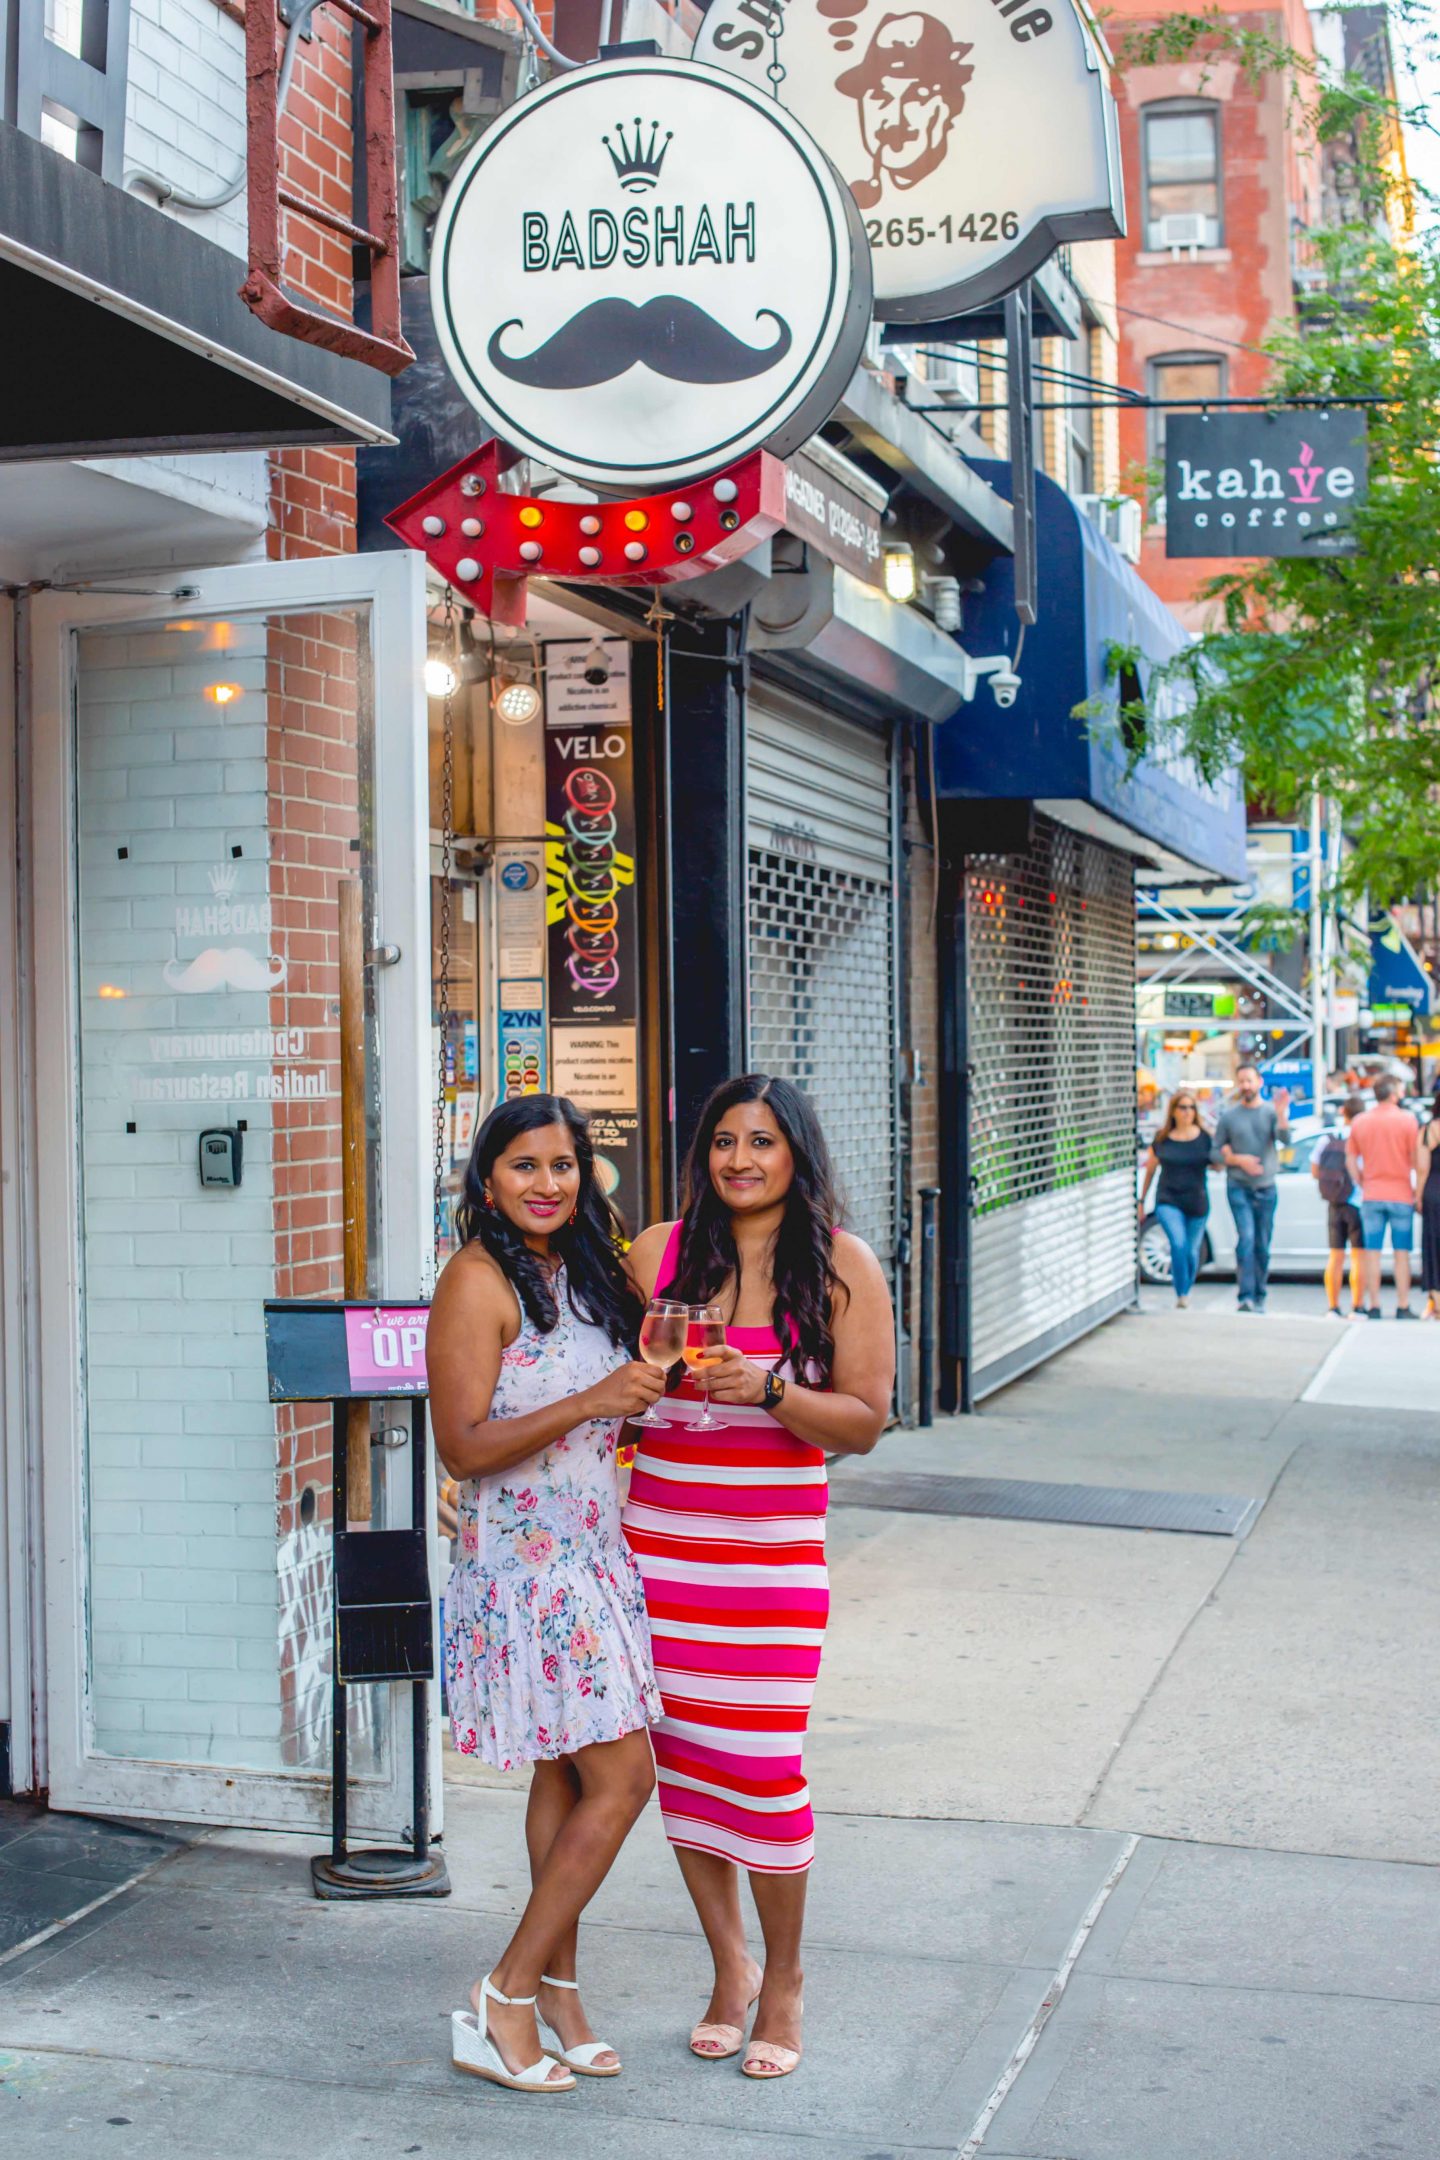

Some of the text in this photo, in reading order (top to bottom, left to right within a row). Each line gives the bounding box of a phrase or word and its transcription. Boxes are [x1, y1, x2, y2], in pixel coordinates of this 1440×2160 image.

[523, 201, 755, 272] BADSHAH
[865, 211, 1019, 248] 265-1426
[1177, 458, 1355, 503] kahve
[1194, 508, 1338, 528] coffee
[554, 735, 626, 760] VELO
[503, 1012, 542, 1028] ZYN
[373, 1327, 426, 1367] OP
